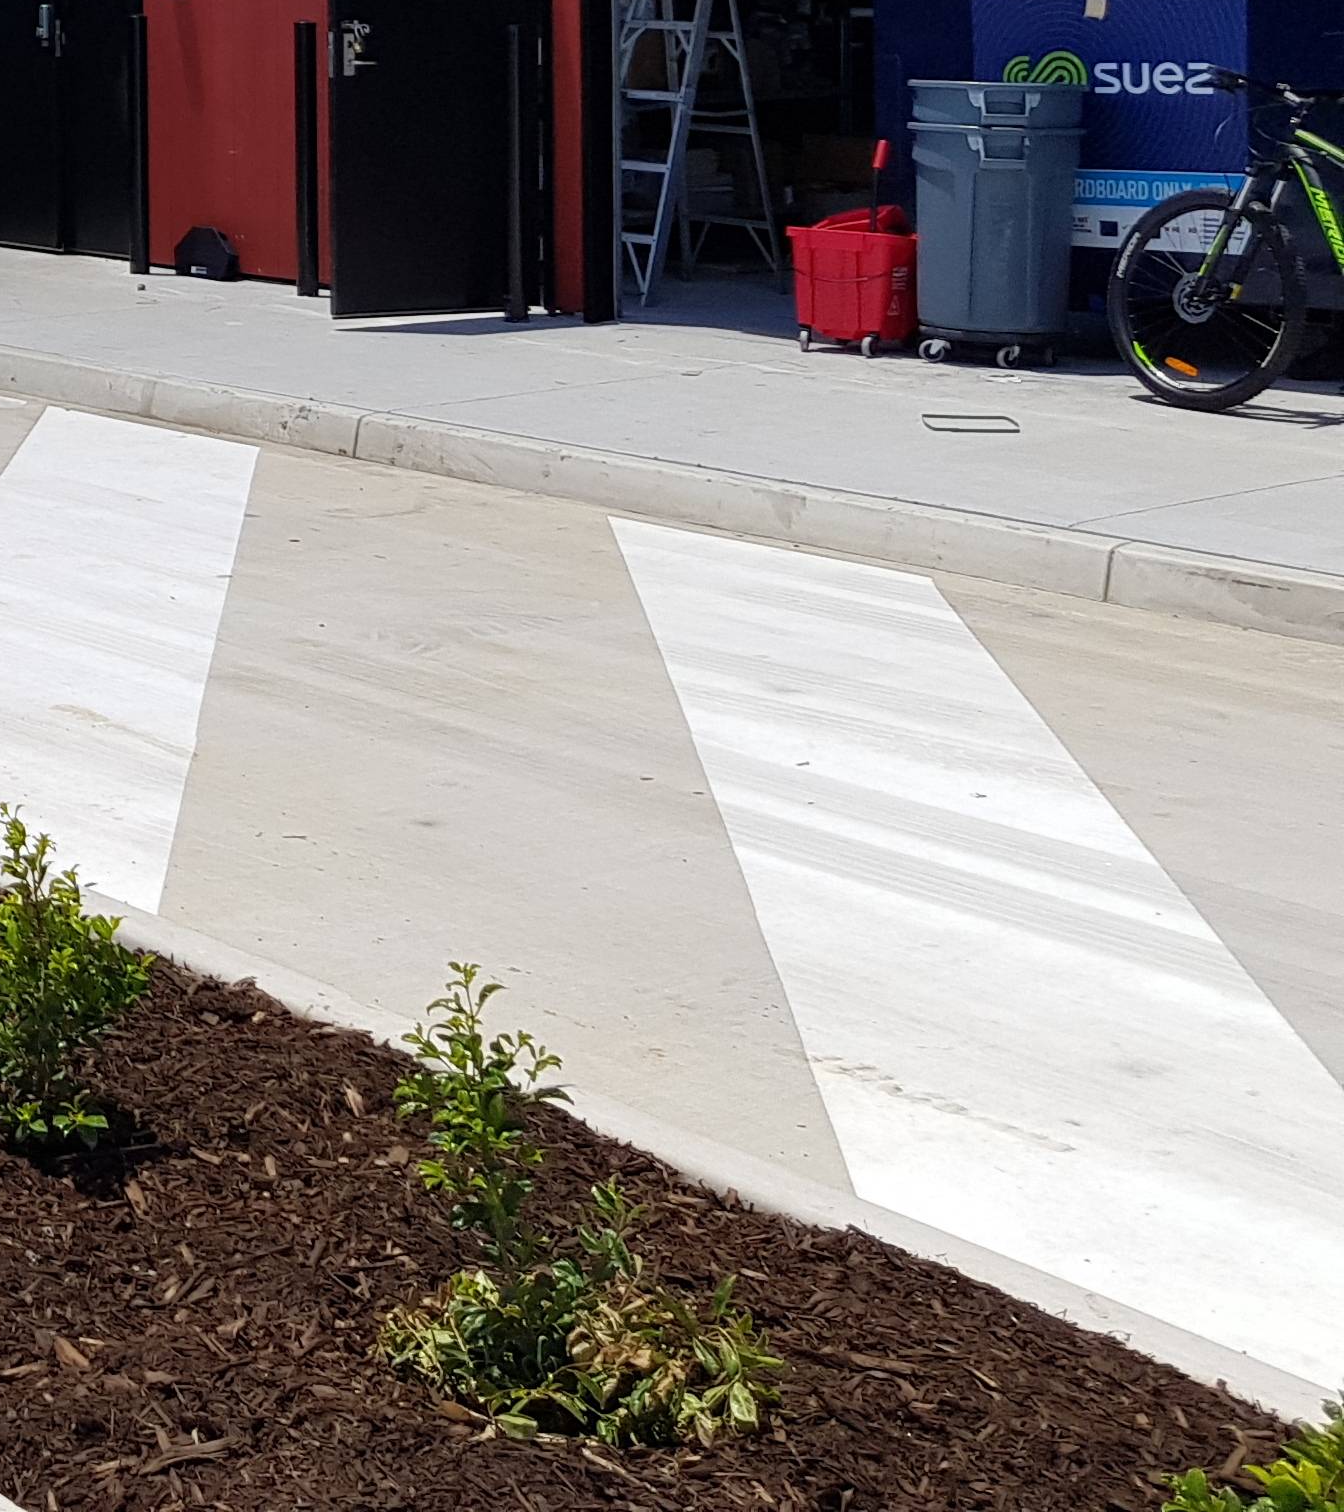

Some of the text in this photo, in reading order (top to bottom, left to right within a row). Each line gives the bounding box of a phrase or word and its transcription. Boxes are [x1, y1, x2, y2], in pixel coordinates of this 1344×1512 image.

[1094, 61, 1215, 95] suez
[1075, 179, 1150, 201] RDBOARD
[1308, 186, 1344, 266] MERID
